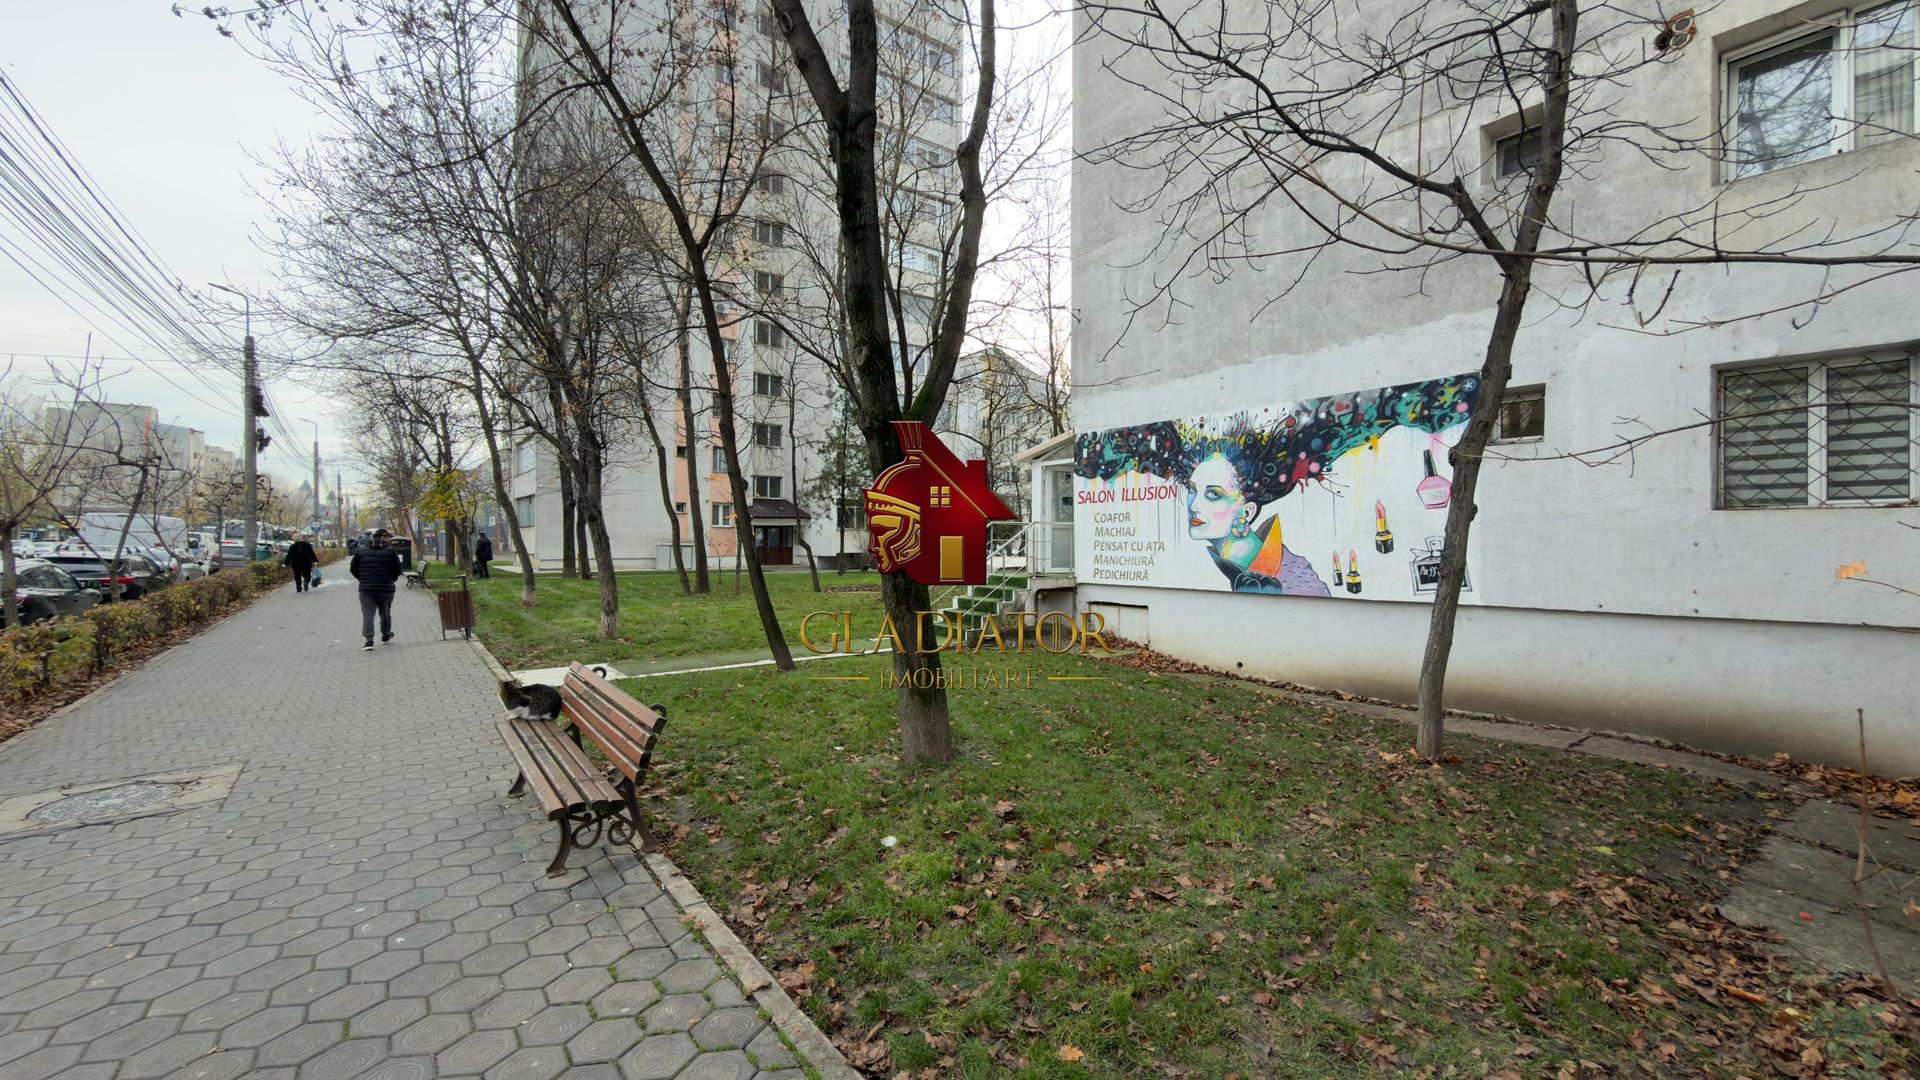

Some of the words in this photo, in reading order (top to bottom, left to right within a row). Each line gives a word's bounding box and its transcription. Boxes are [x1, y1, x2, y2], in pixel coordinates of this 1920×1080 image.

[1078, 490, 1115, 504] SALON
[1121, 485, 1177, 501] ILLUSION
[1094, 512, 1131, 523] COAFOR
[1094, 526, 1136, 537] MACHIAJ
[1093, 540, 1128, 551] PENSAT
[1130, 541, 1143, 552] CU
[1093, 554, 1154, 567] MANICHIURĂ
[1093, 568, 1149, 581] PEDICHIURĂ
